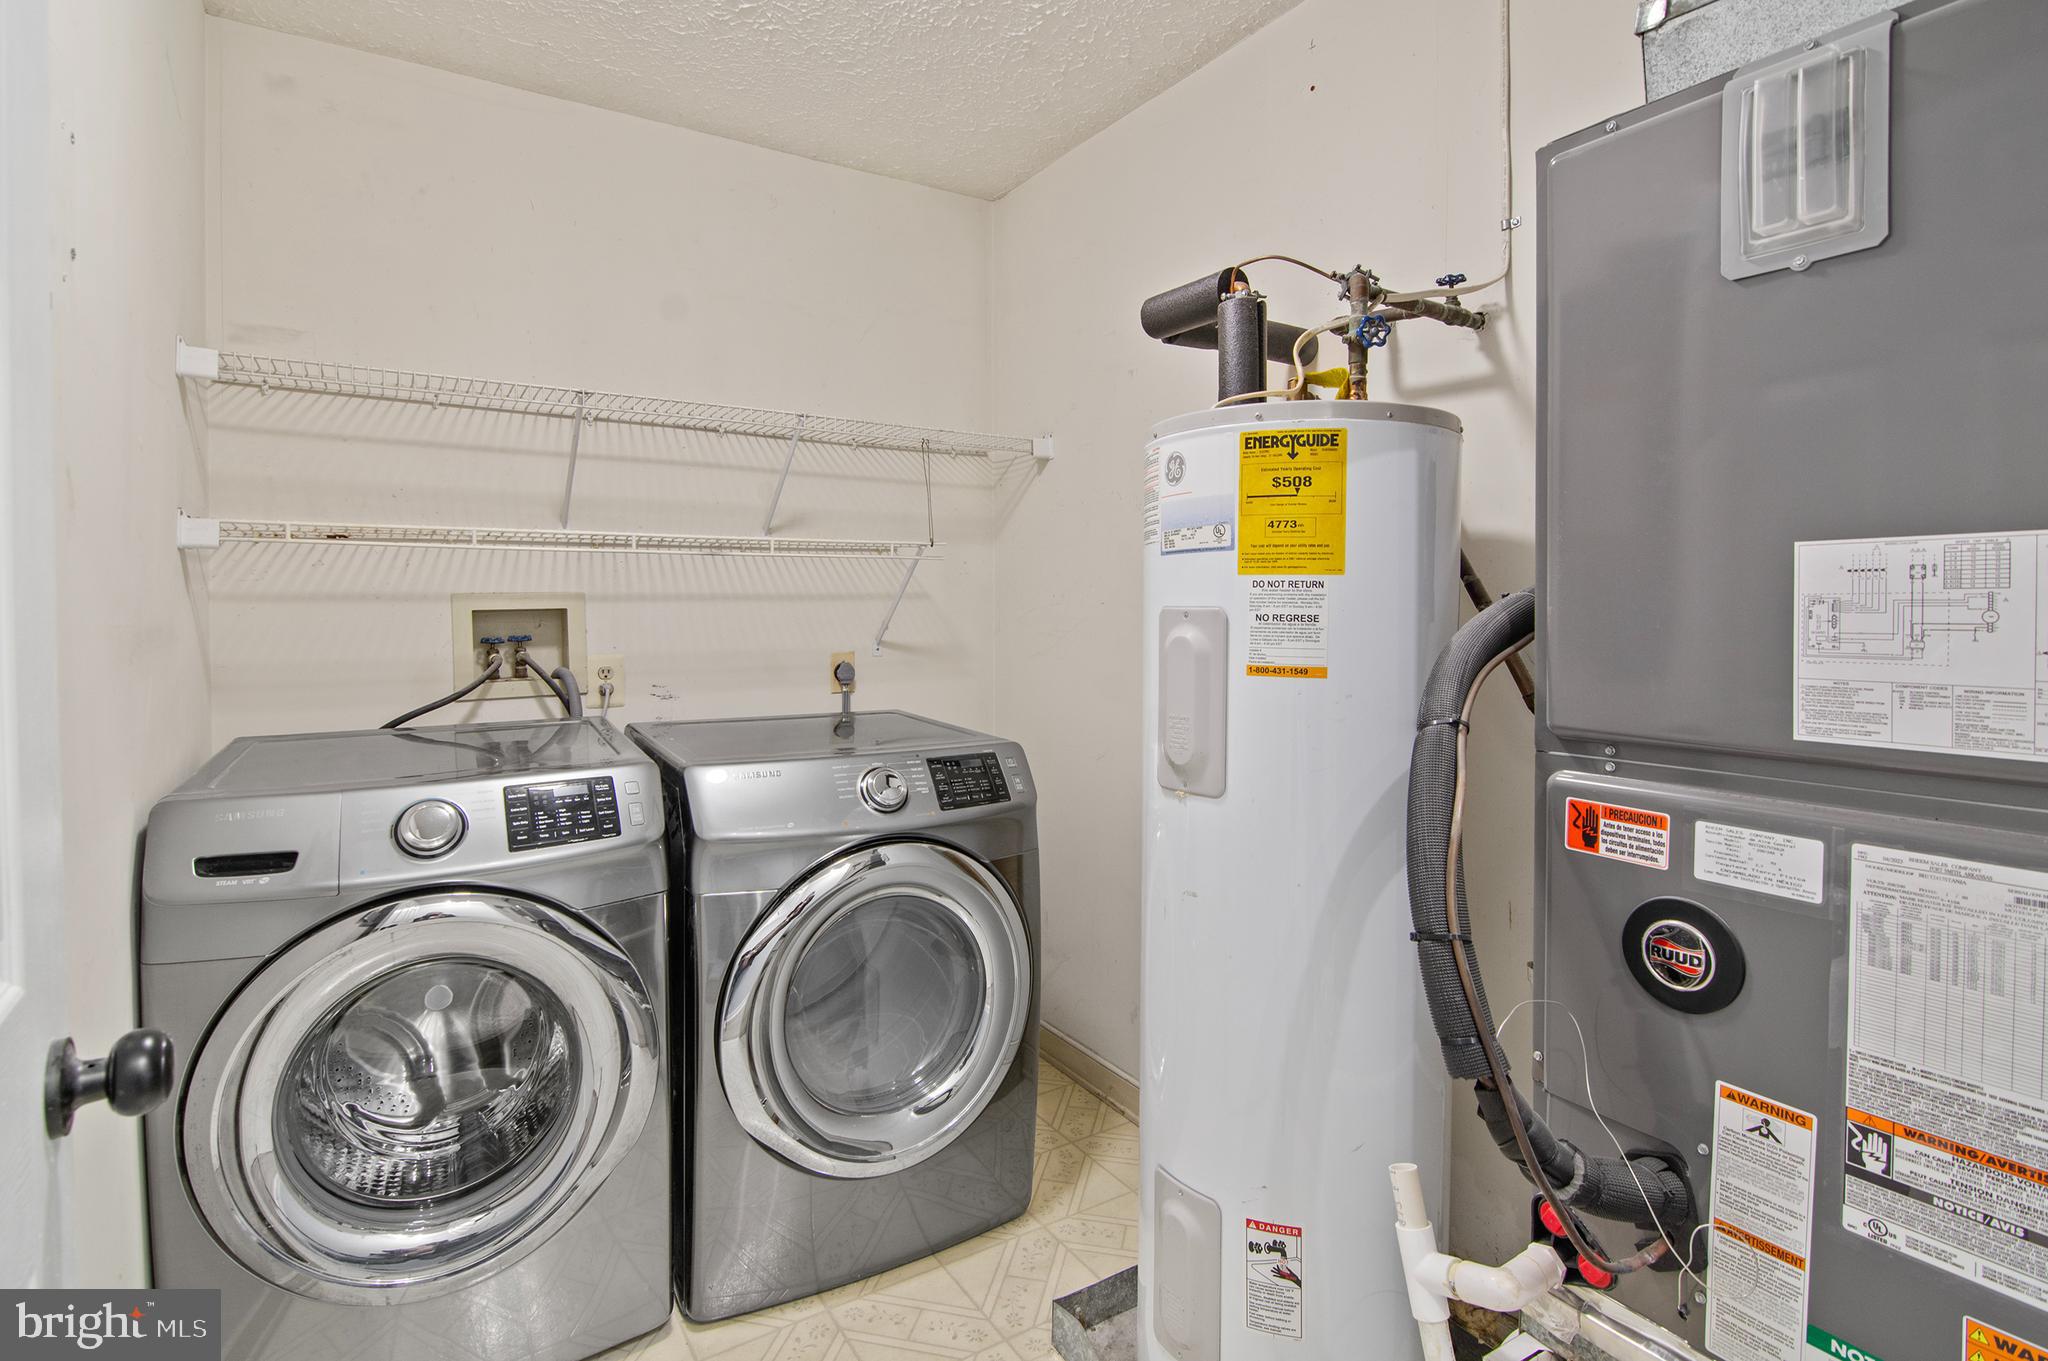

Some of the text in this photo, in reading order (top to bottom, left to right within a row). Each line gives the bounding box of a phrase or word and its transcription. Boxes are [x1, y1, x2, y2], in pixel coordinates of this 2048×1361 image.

[1244, 434, 1339, 450] ENERGYGUIDE
[1272, 476, 1312, 488] $508
[1268, 520, 1297, 528] 4773
[1252, 580, 1265, 588] DO
[1288, 581, 1325, 589] RETURN
[1256, 614, 1320, 623] NO REGRESE
[1249, 667, 1308, 675] 1-800-431-1549
[1604, 821, 1615, 829] Antes
[1609, 809, 1657, 826] PRECAUCION
[1601, 829, 1665, 848] dispositivos terminales, todos
[1605, 846, 1618, 854] deben
[1627, 851, 1658, 863] interrumpidos.
[1651, 944, 1702, 967] RUUD
[1737, 1093, 1807, 1127] WARNING
[1952, 1156, 2014, 1182] HAZARDOUS
[1950, 1178, 1993, 1198] TENSION
[1933, 1196, 2016, 1239] NOTICE/AVIS
[1259, 1223, 1299, 1236] DANGER
[1867, 1232, 1888, 1245] LISTED
